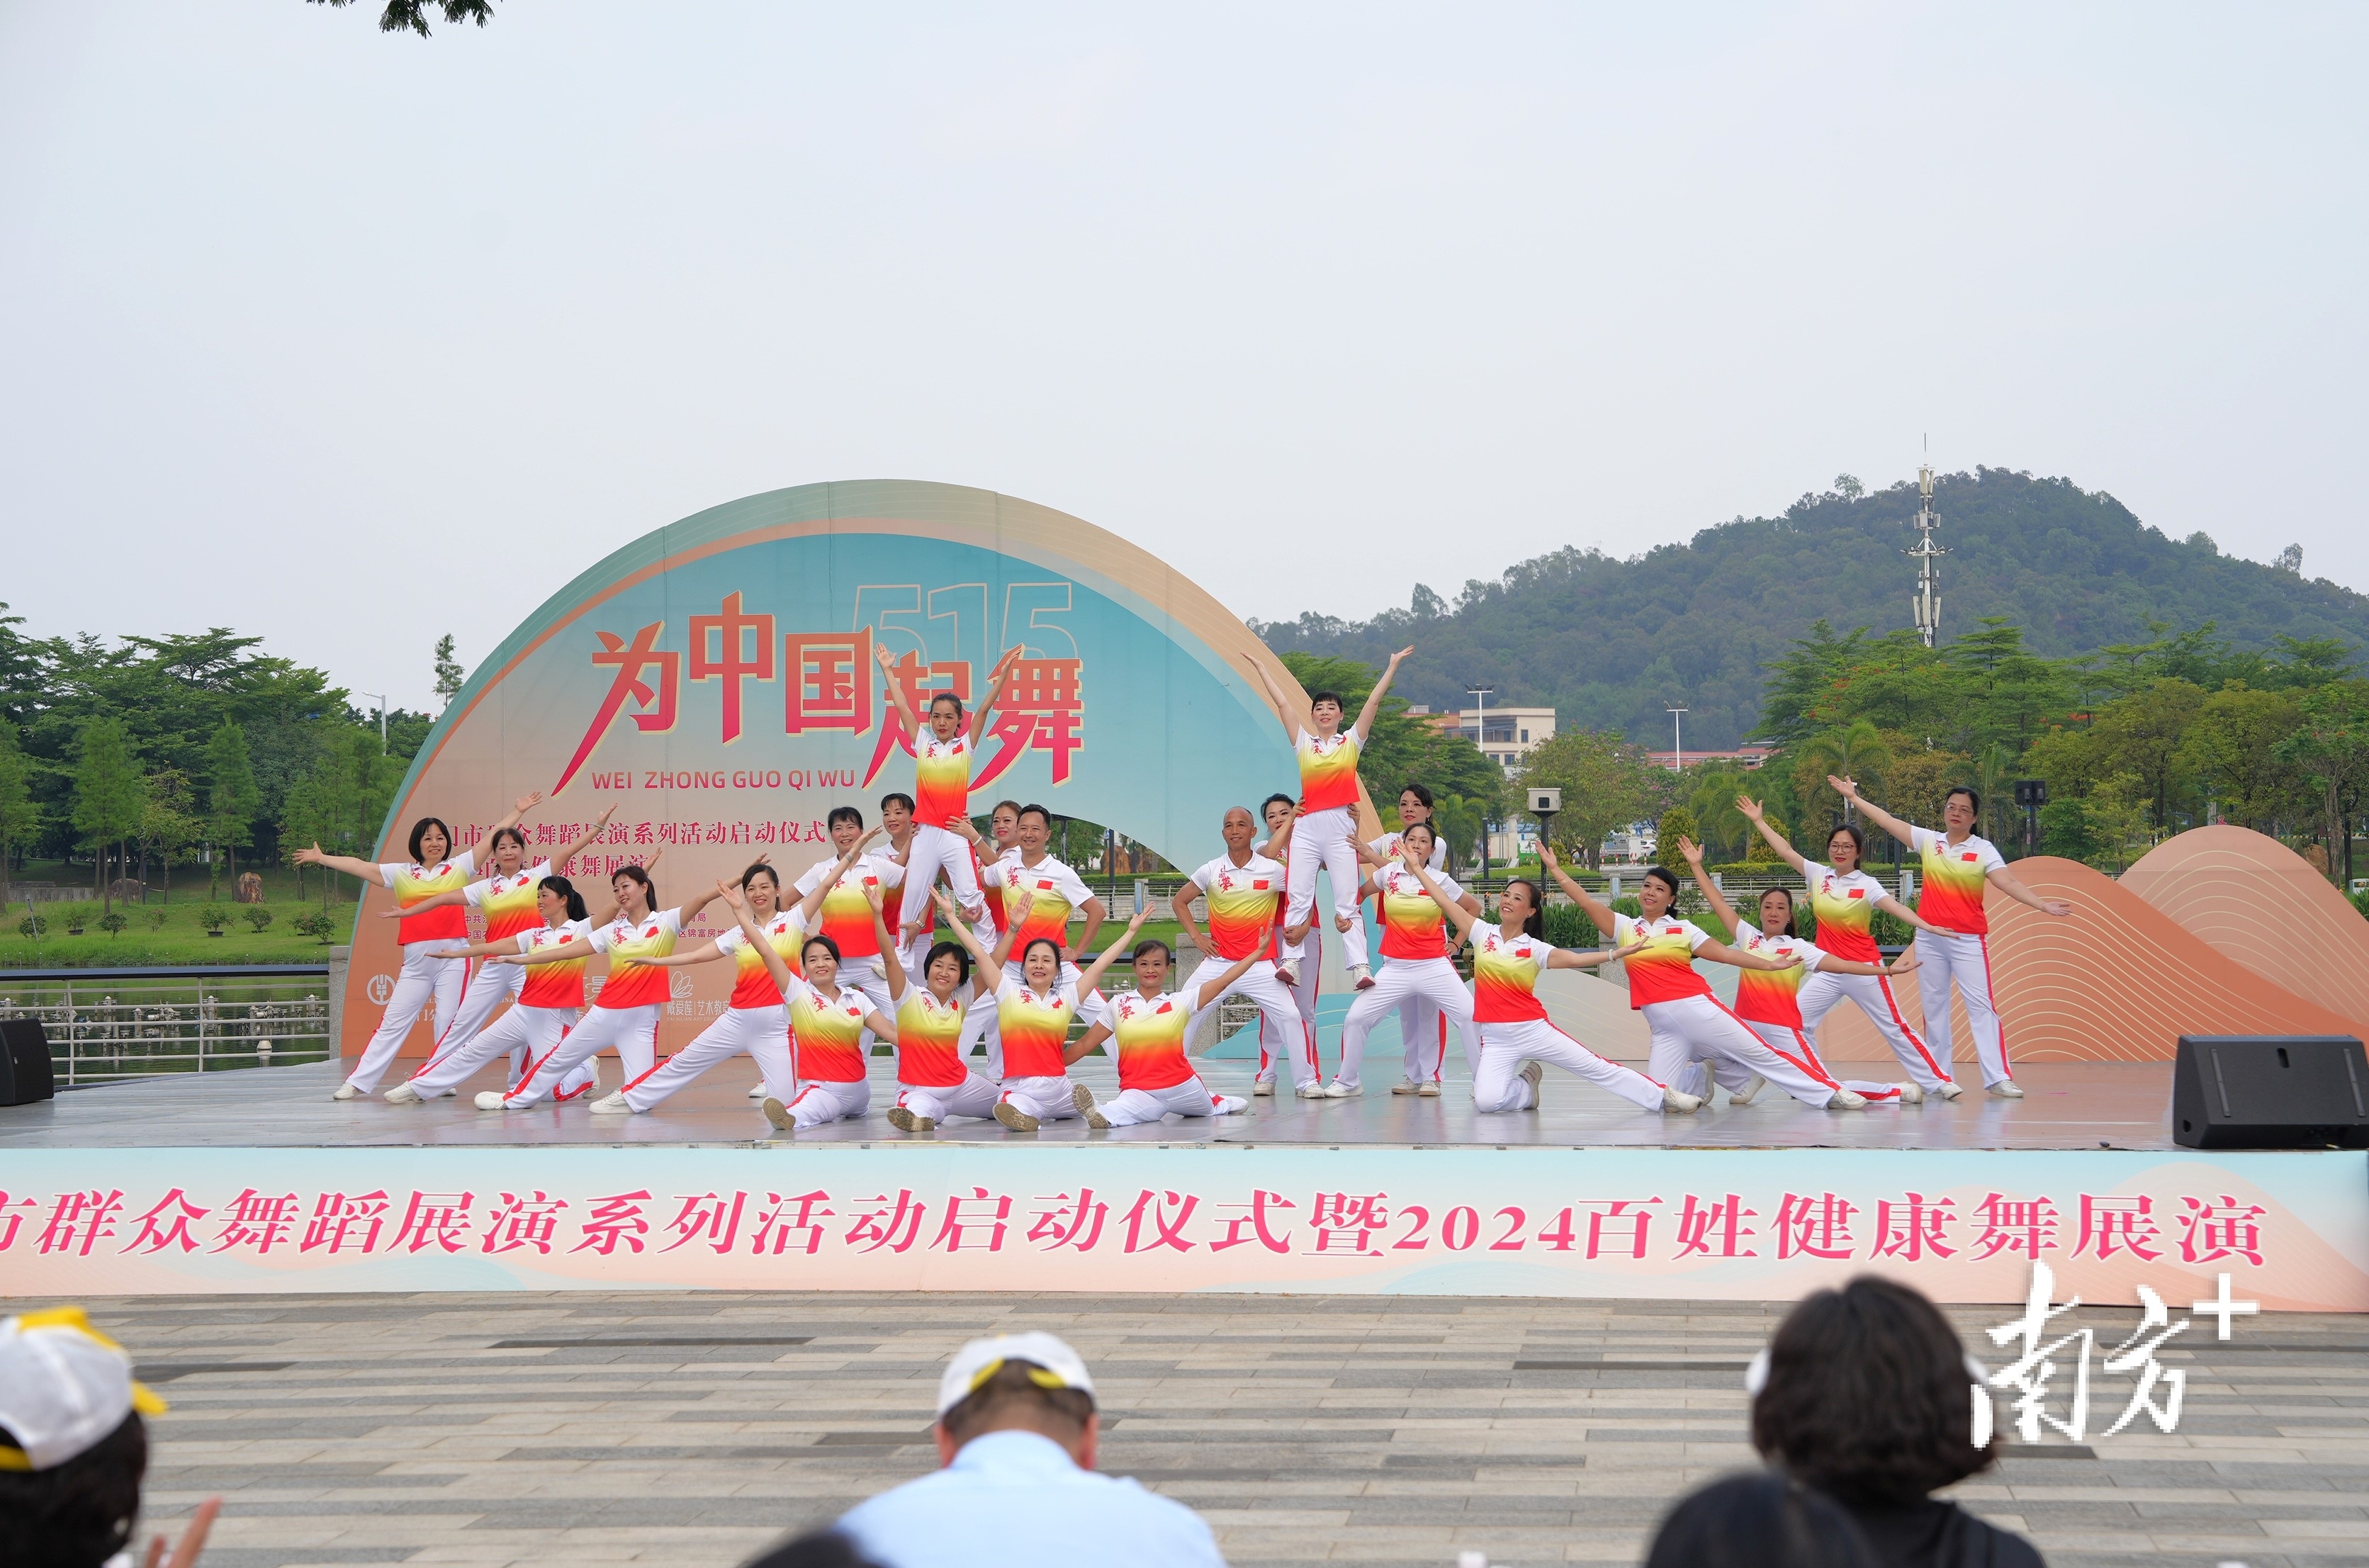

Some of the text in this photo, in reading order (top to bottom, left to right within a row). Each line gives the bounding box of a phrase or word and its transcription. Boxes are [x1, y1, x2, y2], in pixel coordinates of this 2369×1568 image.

[852, 582, 1079, 670] 515
[551, 590, 1085, 798] 为中国起舞
[592, 769, 855, 791] WEI ZHONG GUO QI WU
[678, 928, 733, 938] 区锦富房地
